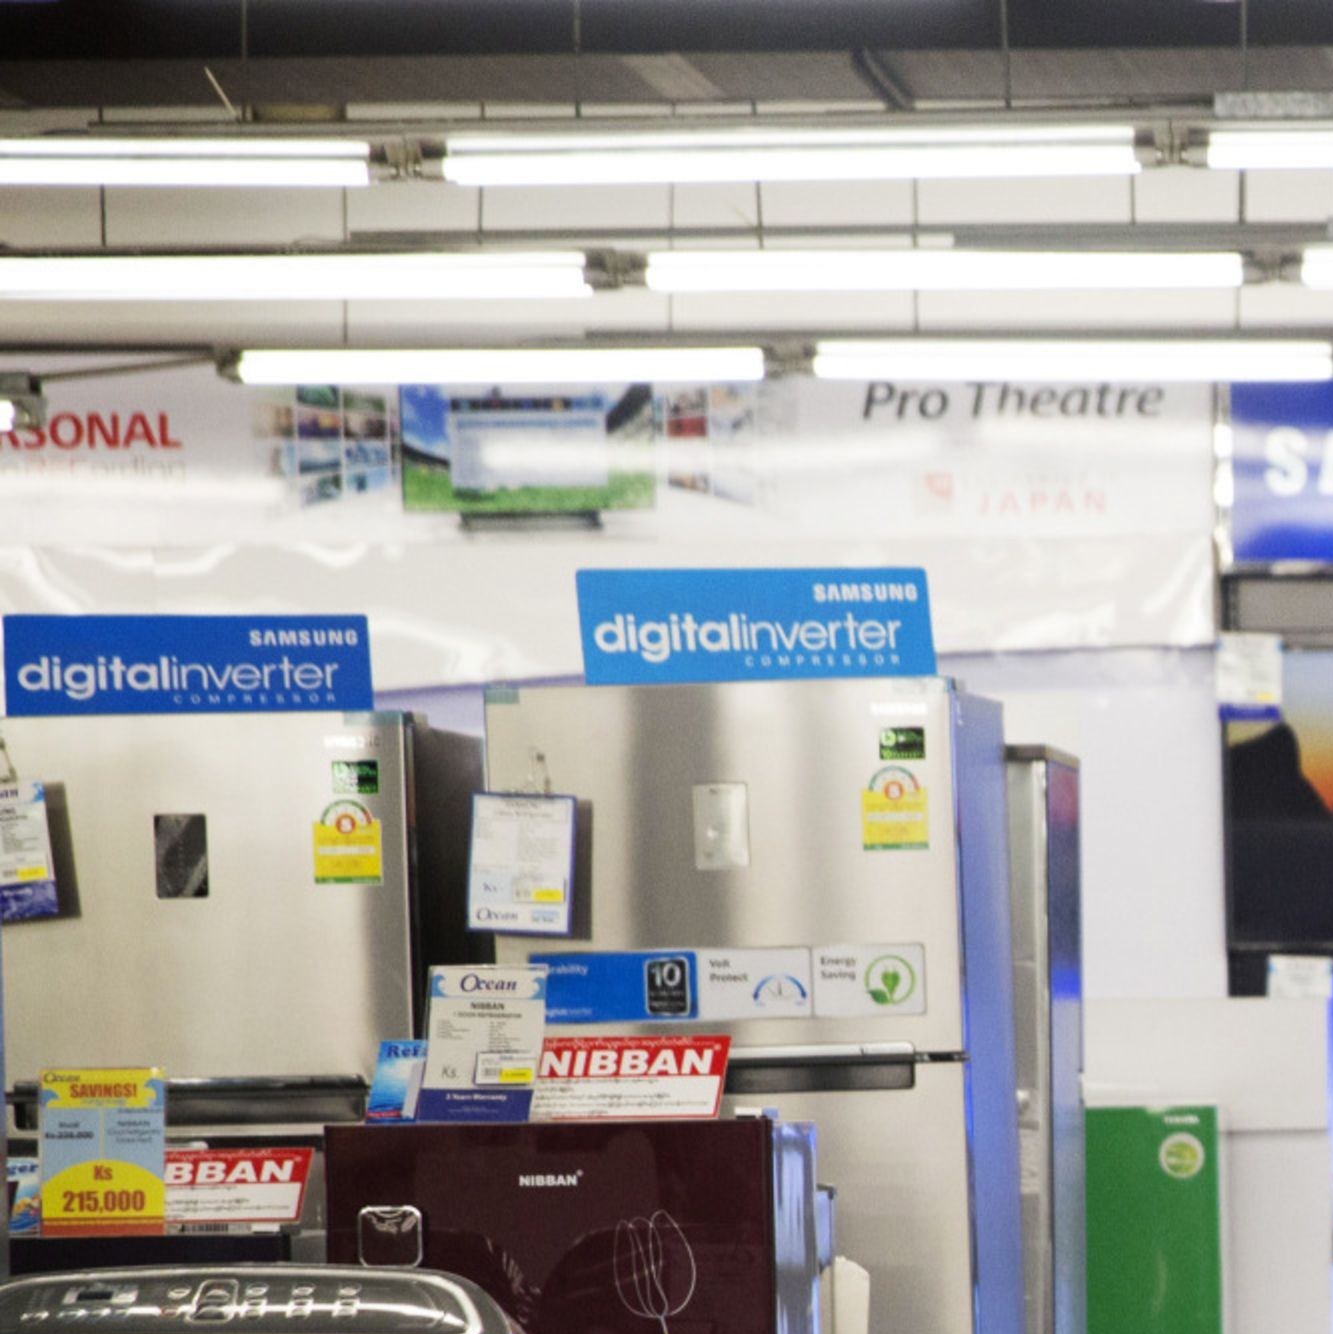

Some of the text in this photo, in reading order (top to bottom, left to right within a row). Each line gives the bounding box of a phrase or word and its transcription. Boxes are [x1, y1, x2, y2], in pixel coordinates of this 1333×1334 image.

[862, 380, 1165, 421] Pro Theatre
[811, 583, 918, 602] SAMSUNG
[249, 629, 358, 647] SAMSUNG
[745, 653, 900, 668] COMPRESSOR
[173, 693, 336, 705] COMPRESSOR
[459, 972, 517, 993] Ocean
[650, 962, 681, 989] 10
[538, 1048, 714, 1076] NIBBAN
[69, 1083, 138, 1098] SAVINGS!
[93, 1165, 113, 1180] Ks
[519, 1174, 578, 1187] NIBBAN
[63, 1190, 146, 1213] 215,000
